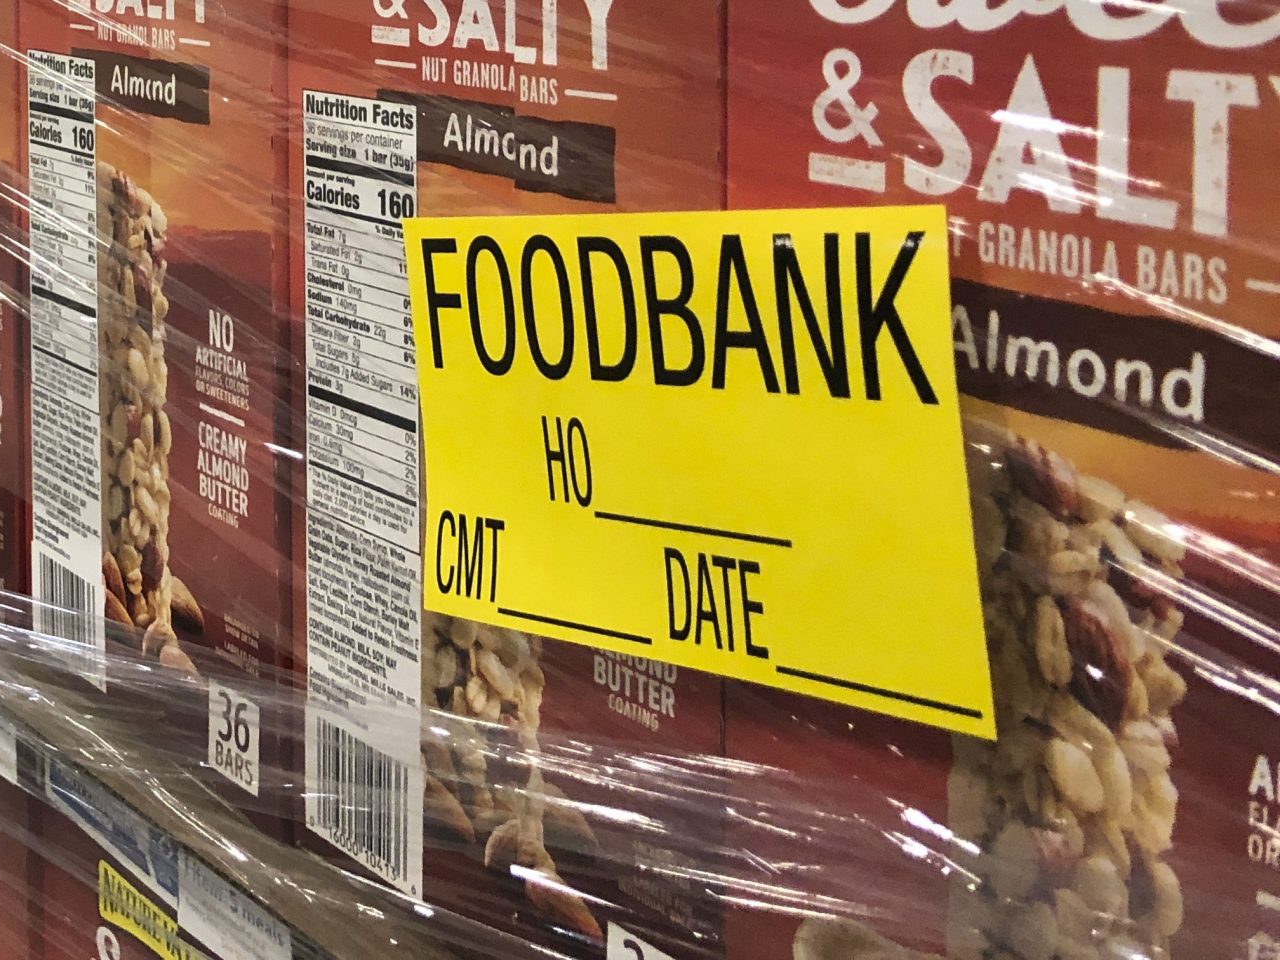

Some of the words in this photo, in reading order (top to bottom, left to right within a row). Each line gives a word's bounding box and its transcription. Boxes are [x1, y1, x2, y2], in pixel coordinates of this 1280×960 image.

[151, 26, 176, 51] BARS
[29, 52, 67, 76] Nutrition
[69, 58, 94, 79] Facts
[421, 56, 448, 84] NUT
[453, 60, 516, 92] GRANOLA
[519, 74, 558, 106] BARS
[305, 93, 368, 123] Nutrition
[372, 103, 414, 130] Facts
[29, 120, 63, 144] Calories
[72, 126, 94, 152] 160
[305, 137, 338, 158] Serving
[339, 144, 357, 160] size
[372, 150, 388, 165] bar
[317, 125, 350, 143] servings
[350, 131, 363, 143] per
[365, 134, 404, 151] container
[443, 112, 560, 177] Almond
[812, 47, 884, 149] &
[902, 48, 1280, 238] SALT
[305, 179, 361, 210] Calories
[377, 188, 415, 219] 160
[306, 221, 323, 237] Total
[323, 226, 336, 239] Fat
[307, 271, 345, 292] Cholesterol
[977, 220, 1121, 285] GRANOLA
[1135, 244, 1228, 304] BARS
[307, 288, 333, 305] Sodium
[208, 309, 234, 354] NO
[324, 308, 371, 334] Carbohydrate
[420, 230, 941, 405] FOODBANK
[195, 344, 250, 382] ARTIFICIAL
[951, 303, 1206, 422] Almond
[195, 379, 205, 393] OR
[205, 381, 250, 412] SWEETENERS
[224, 374, 250, 397] COLORS
[198, 420, 248, 466] CREAMY
[541, 414, 593, 508] HO
[197, 448, 250, 492] ALMOND
[199, 475, 249, 518] BUTTER
[208, 502, 239, 529] COATING
[435, 509, 506, 604] CMT
[664, 546, 769, 660] DATE
[593, 654, 676, 719] BUTTER
[217, 690, 251, 754] 36
[608, 693, 660, 733] COATING
[215, 740, 254, 788] BARS
[328, 825, 360, 857] 16000
[363, 848, 398, 883] 10413
